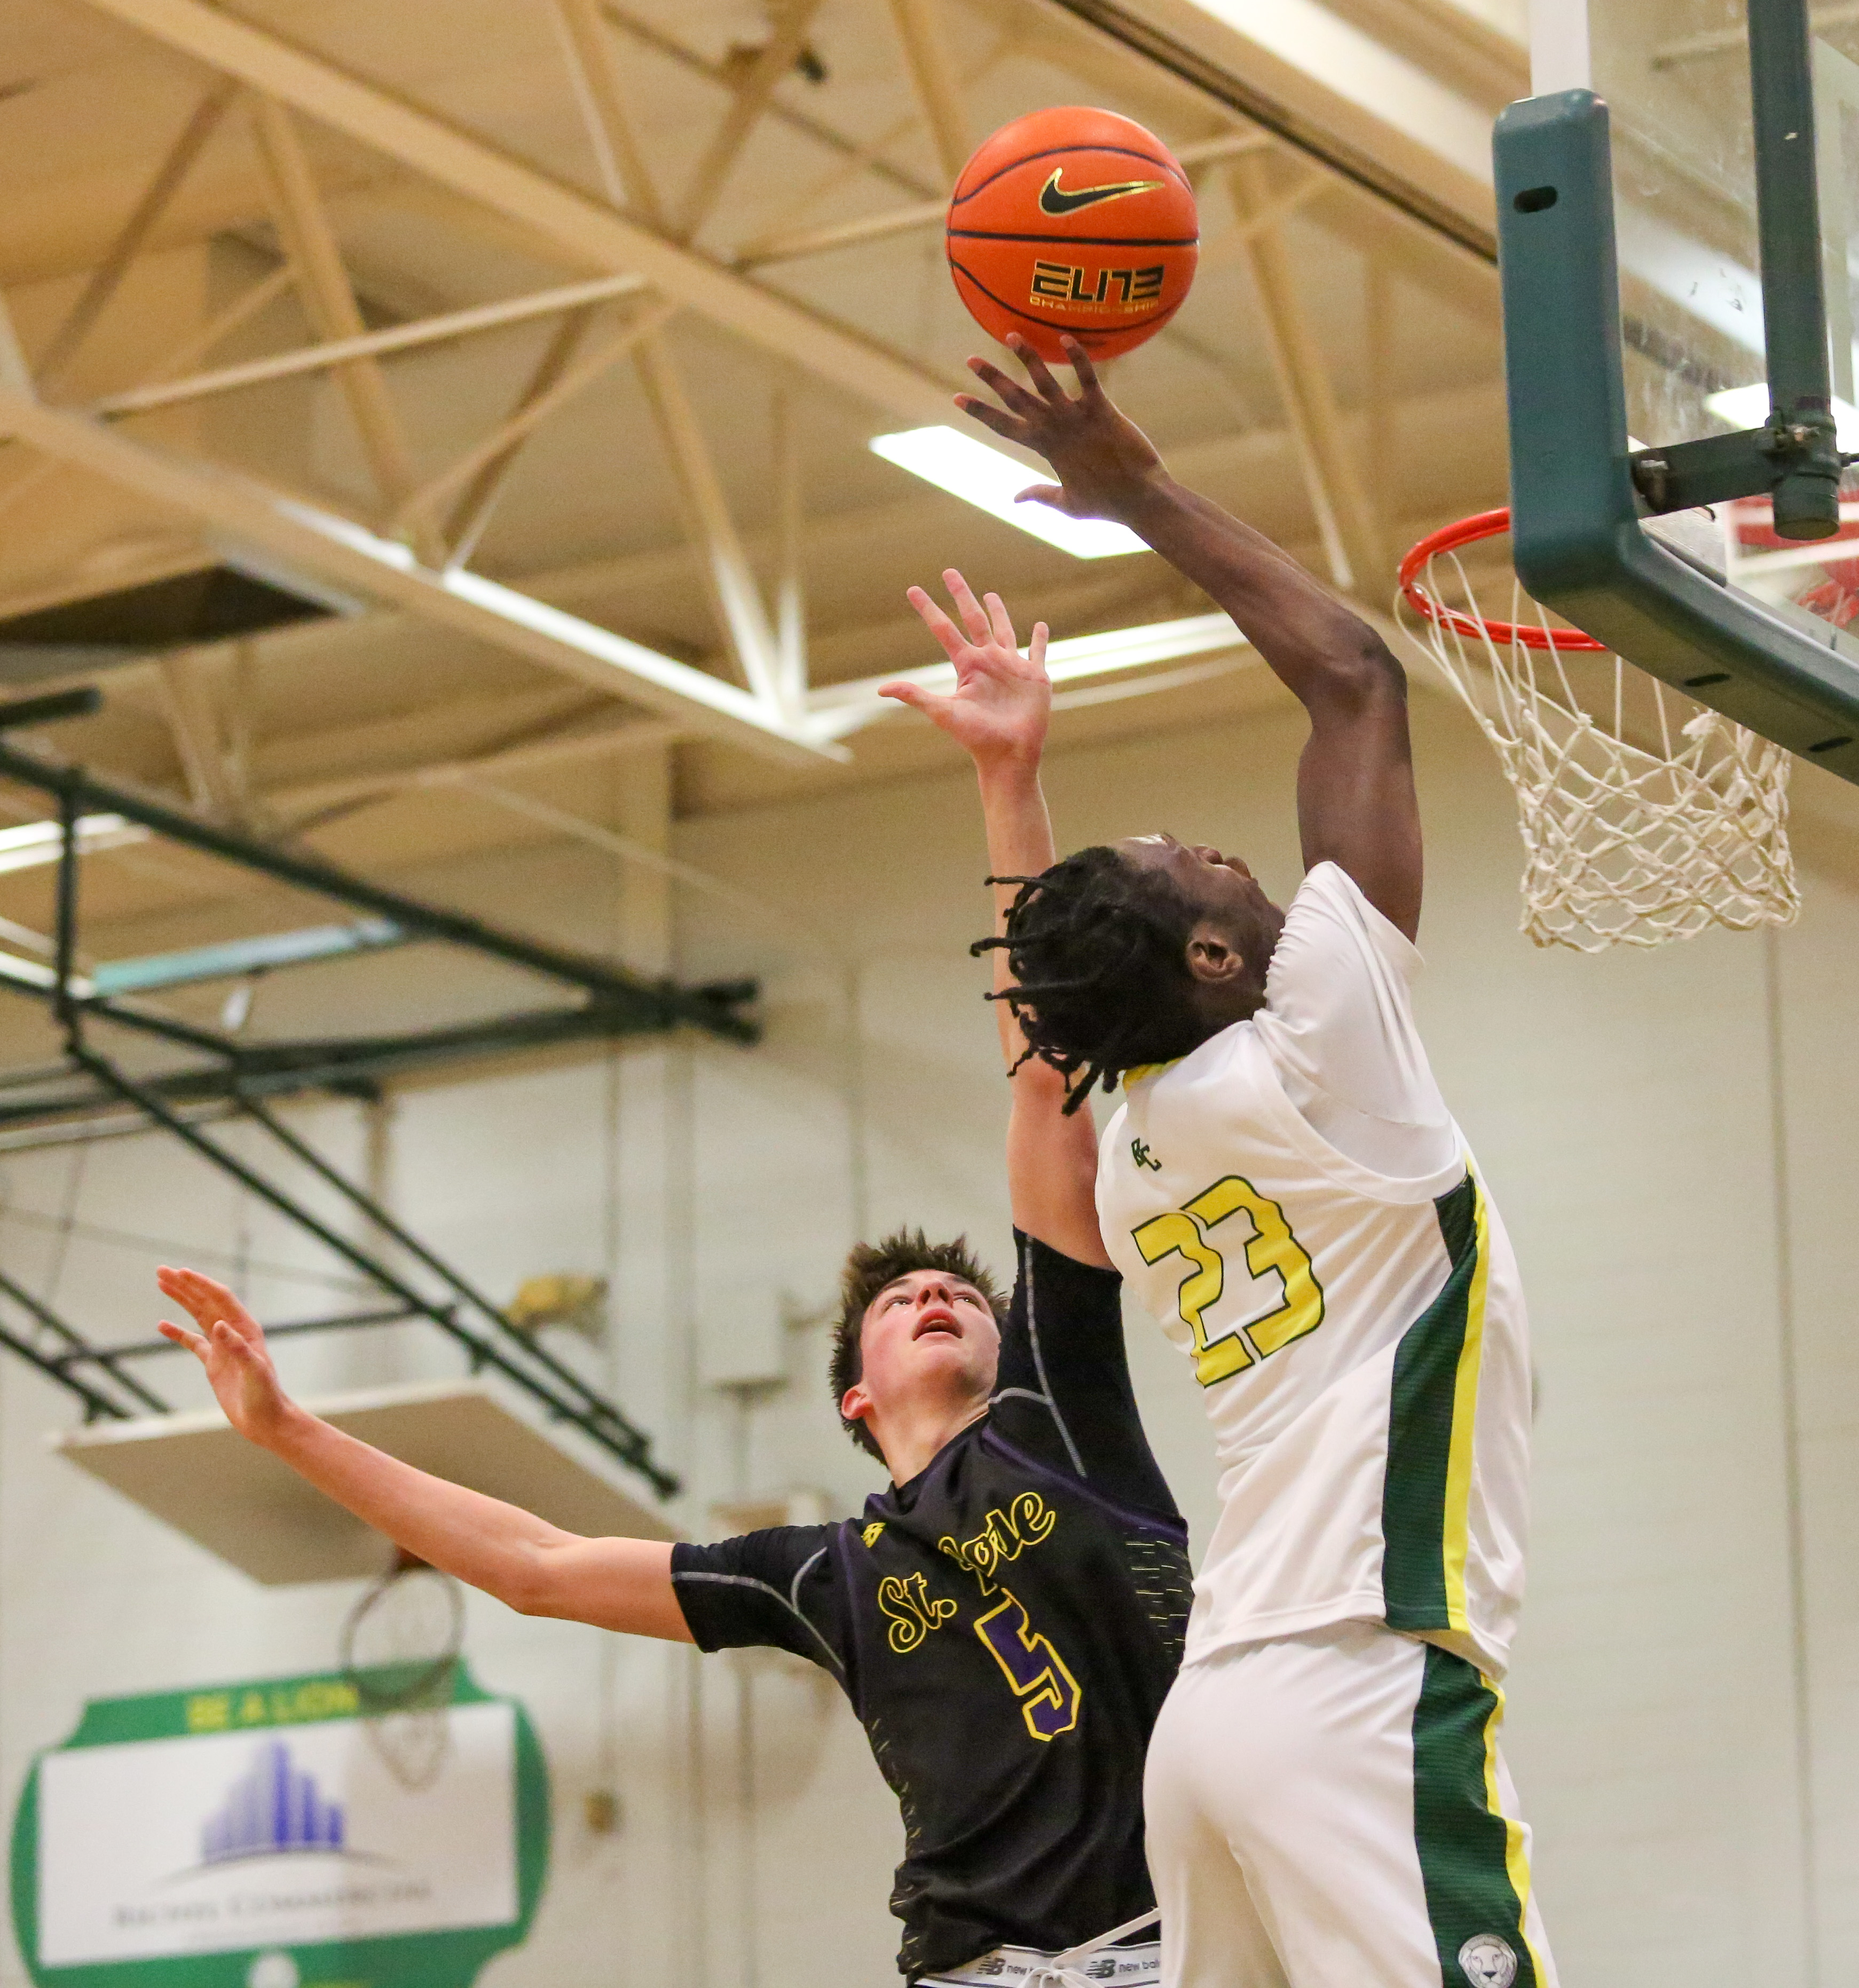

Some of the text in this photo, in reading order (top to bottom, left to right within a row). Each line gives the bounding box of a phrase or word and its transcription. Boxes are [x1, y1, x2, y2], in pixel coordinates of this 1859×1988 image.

[1031, 259, 1165, 303] ELITE
[1030, 295, 1159, 314] CHAMPIOSHIP
[1130, 1175, 1325, 1388] 23
[878, 1572, 957, 1653] St.
[974, 1588, 1082, 1741] 5
[1007, 1965, 1028, 1975] new
[1119, 1963, 1140, 1973] new
